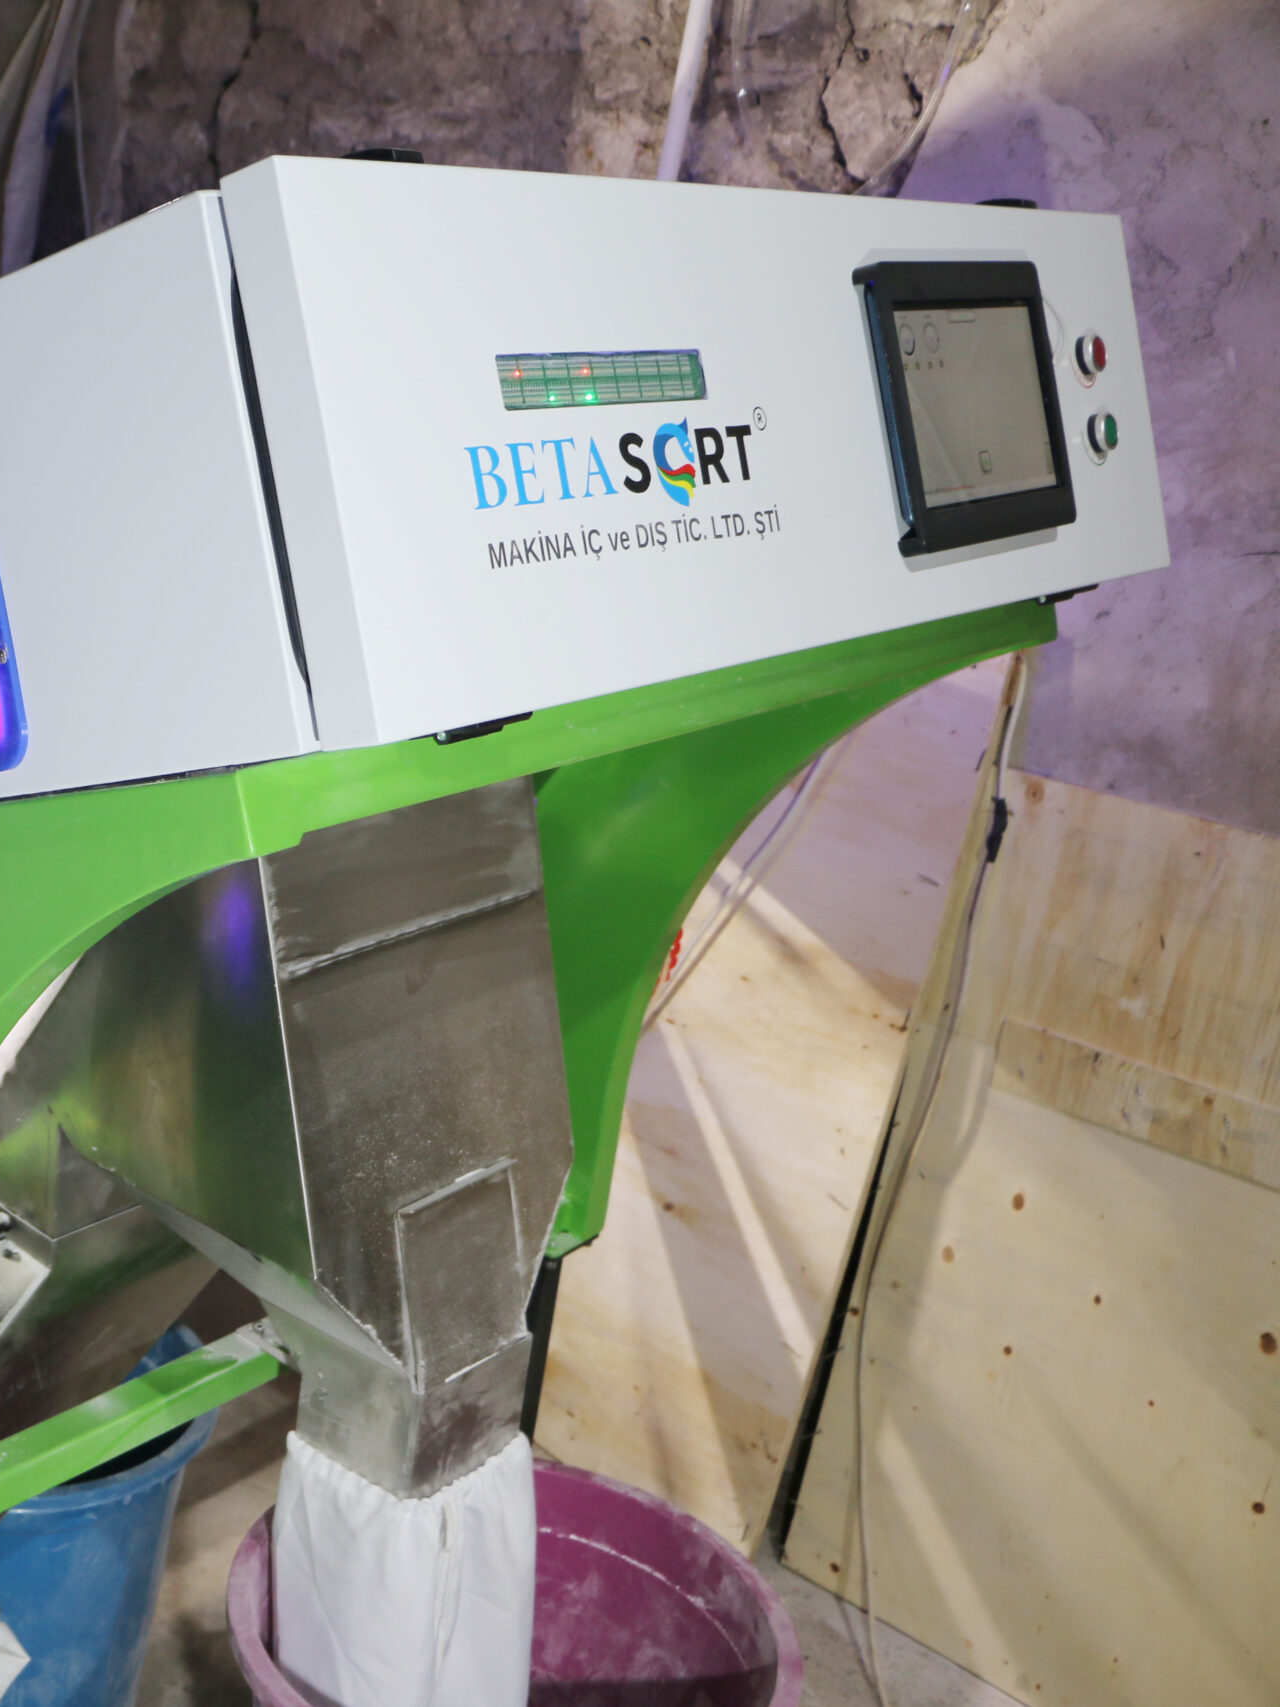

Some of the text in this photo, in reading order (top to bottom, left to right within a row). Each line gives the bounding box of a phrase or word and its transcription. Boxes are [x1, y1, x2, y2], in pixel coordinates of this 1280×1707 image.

[487, 504, 781, 569] MAKİNA İÇ ve DIŞ TİC. LTD. ŞTİ
